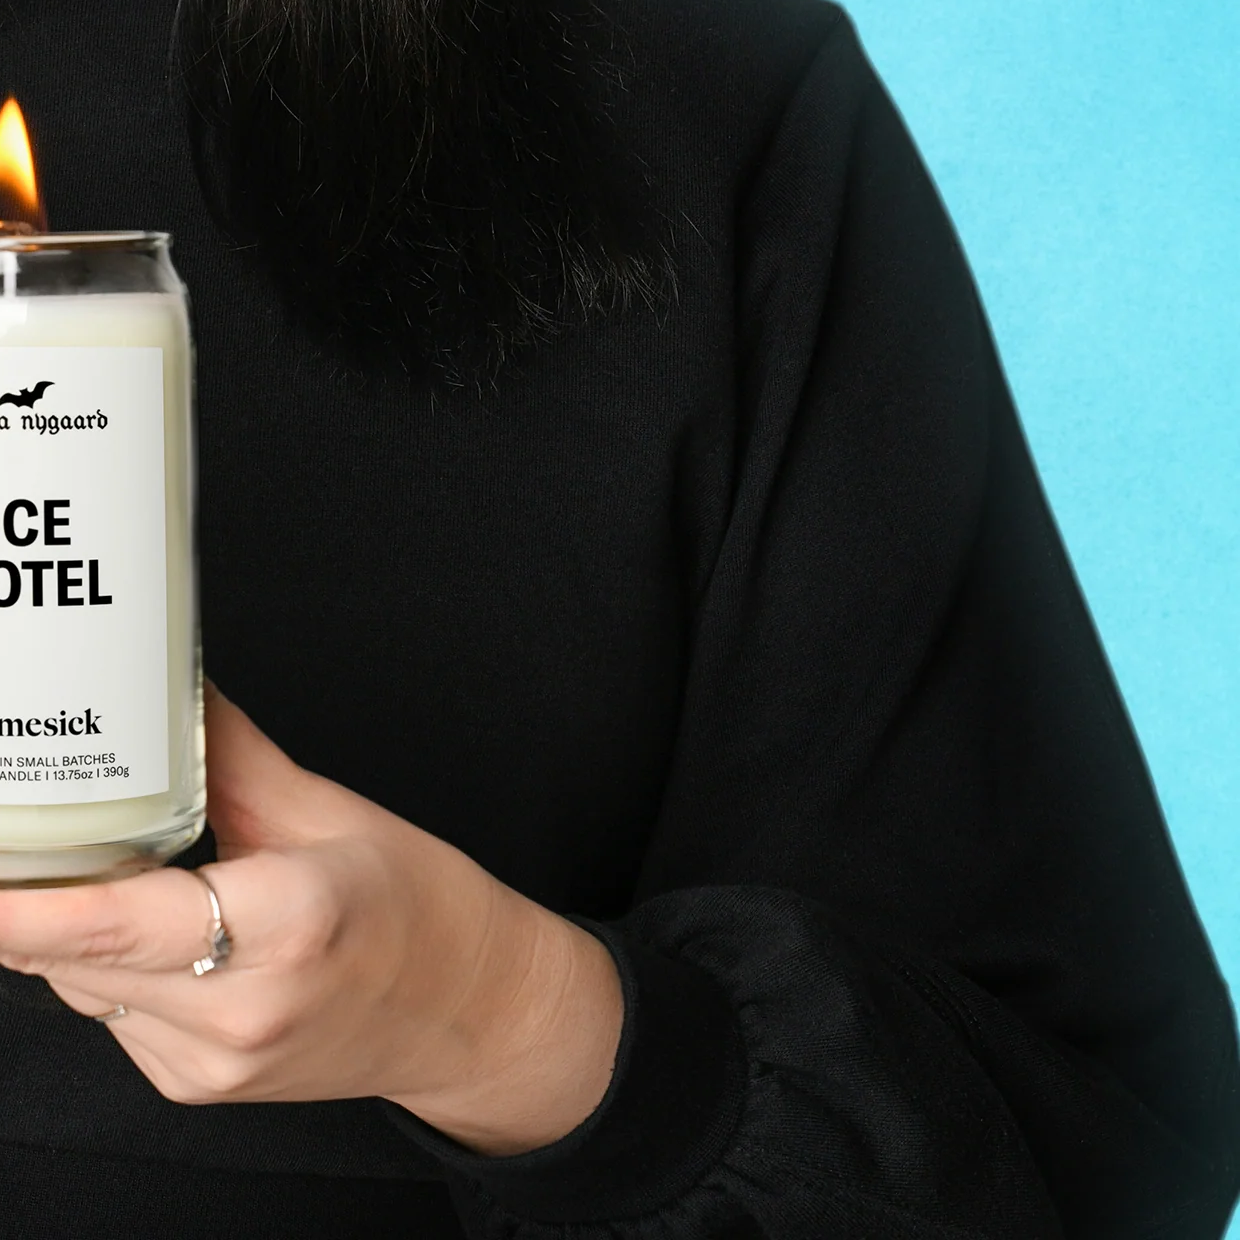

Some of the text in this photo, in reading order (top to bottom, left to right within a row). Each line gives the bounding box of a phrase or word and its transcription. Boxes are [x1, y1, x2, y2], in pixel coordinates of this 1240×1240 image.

[20, 408, 109, 436] nygaard
[0, 757, 13, 768] IN
[16, 756, 59, 768] SMALL
[62, 752, 116, 767] BATCHES
[53, 769, 94, 781] 13.75oz
[103, 766, 130, 778] 390g
